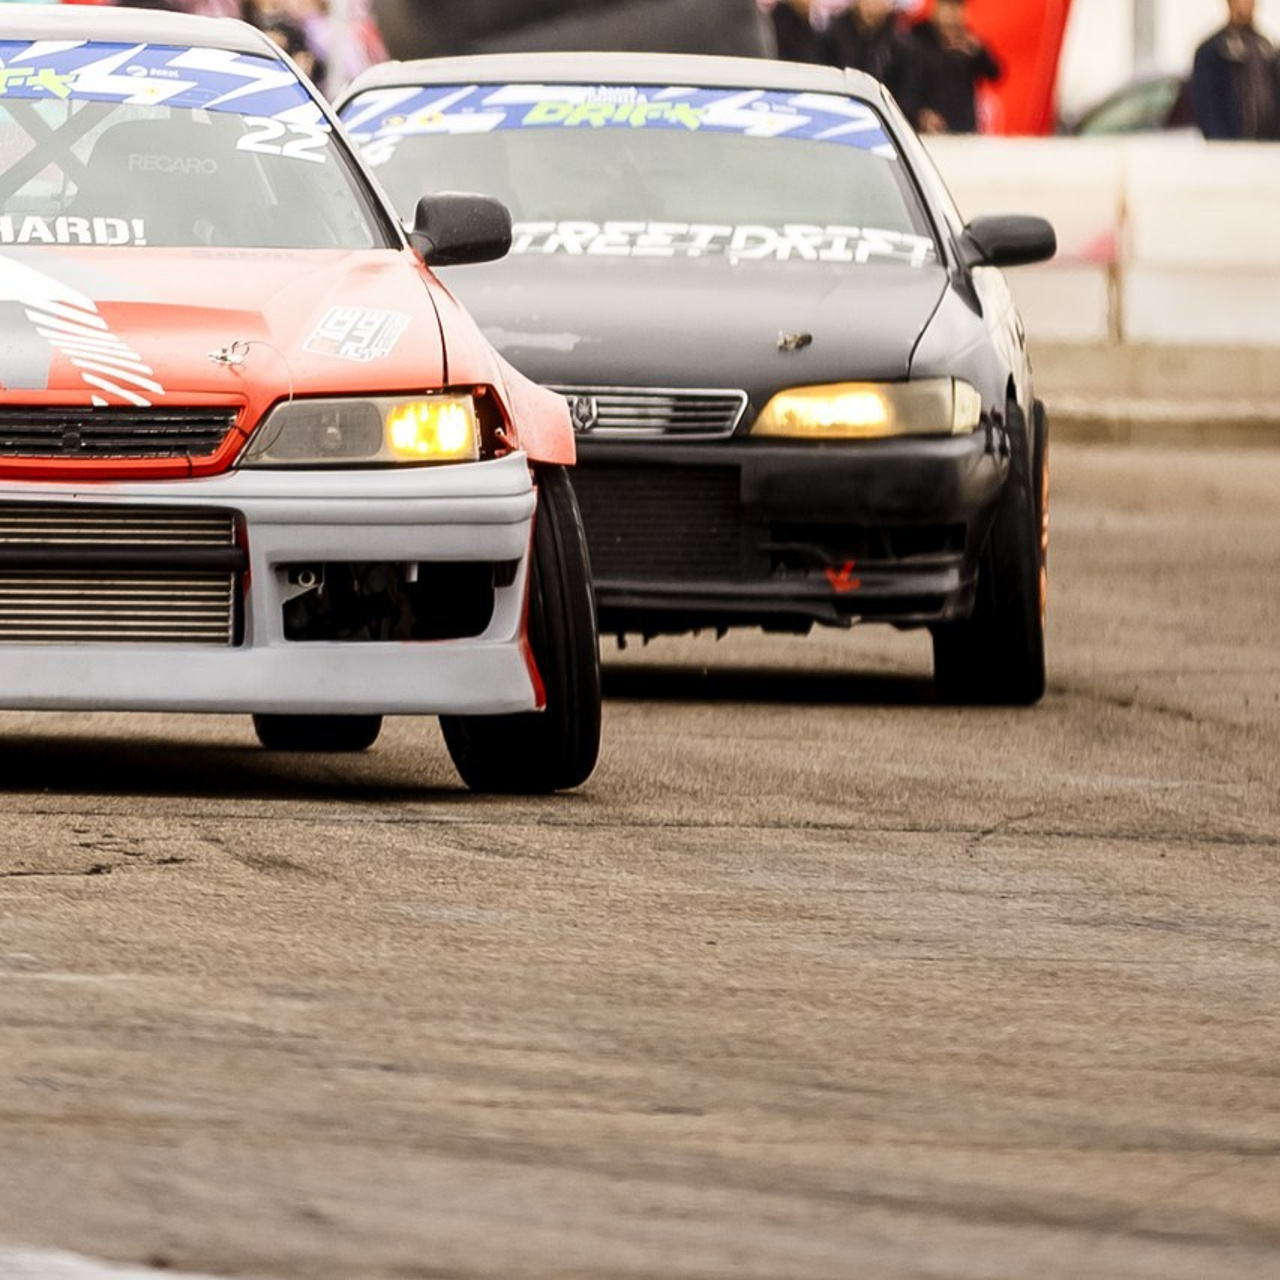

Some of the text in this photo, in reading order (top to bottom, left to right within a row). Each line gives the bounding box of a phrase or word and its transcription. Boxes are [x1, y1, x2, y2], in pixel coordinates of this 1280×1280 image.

[522, 100, 709, 131] DRIFT
[236, 116, 332, 163] 22
[128, 152, 217, 175] RECARO
